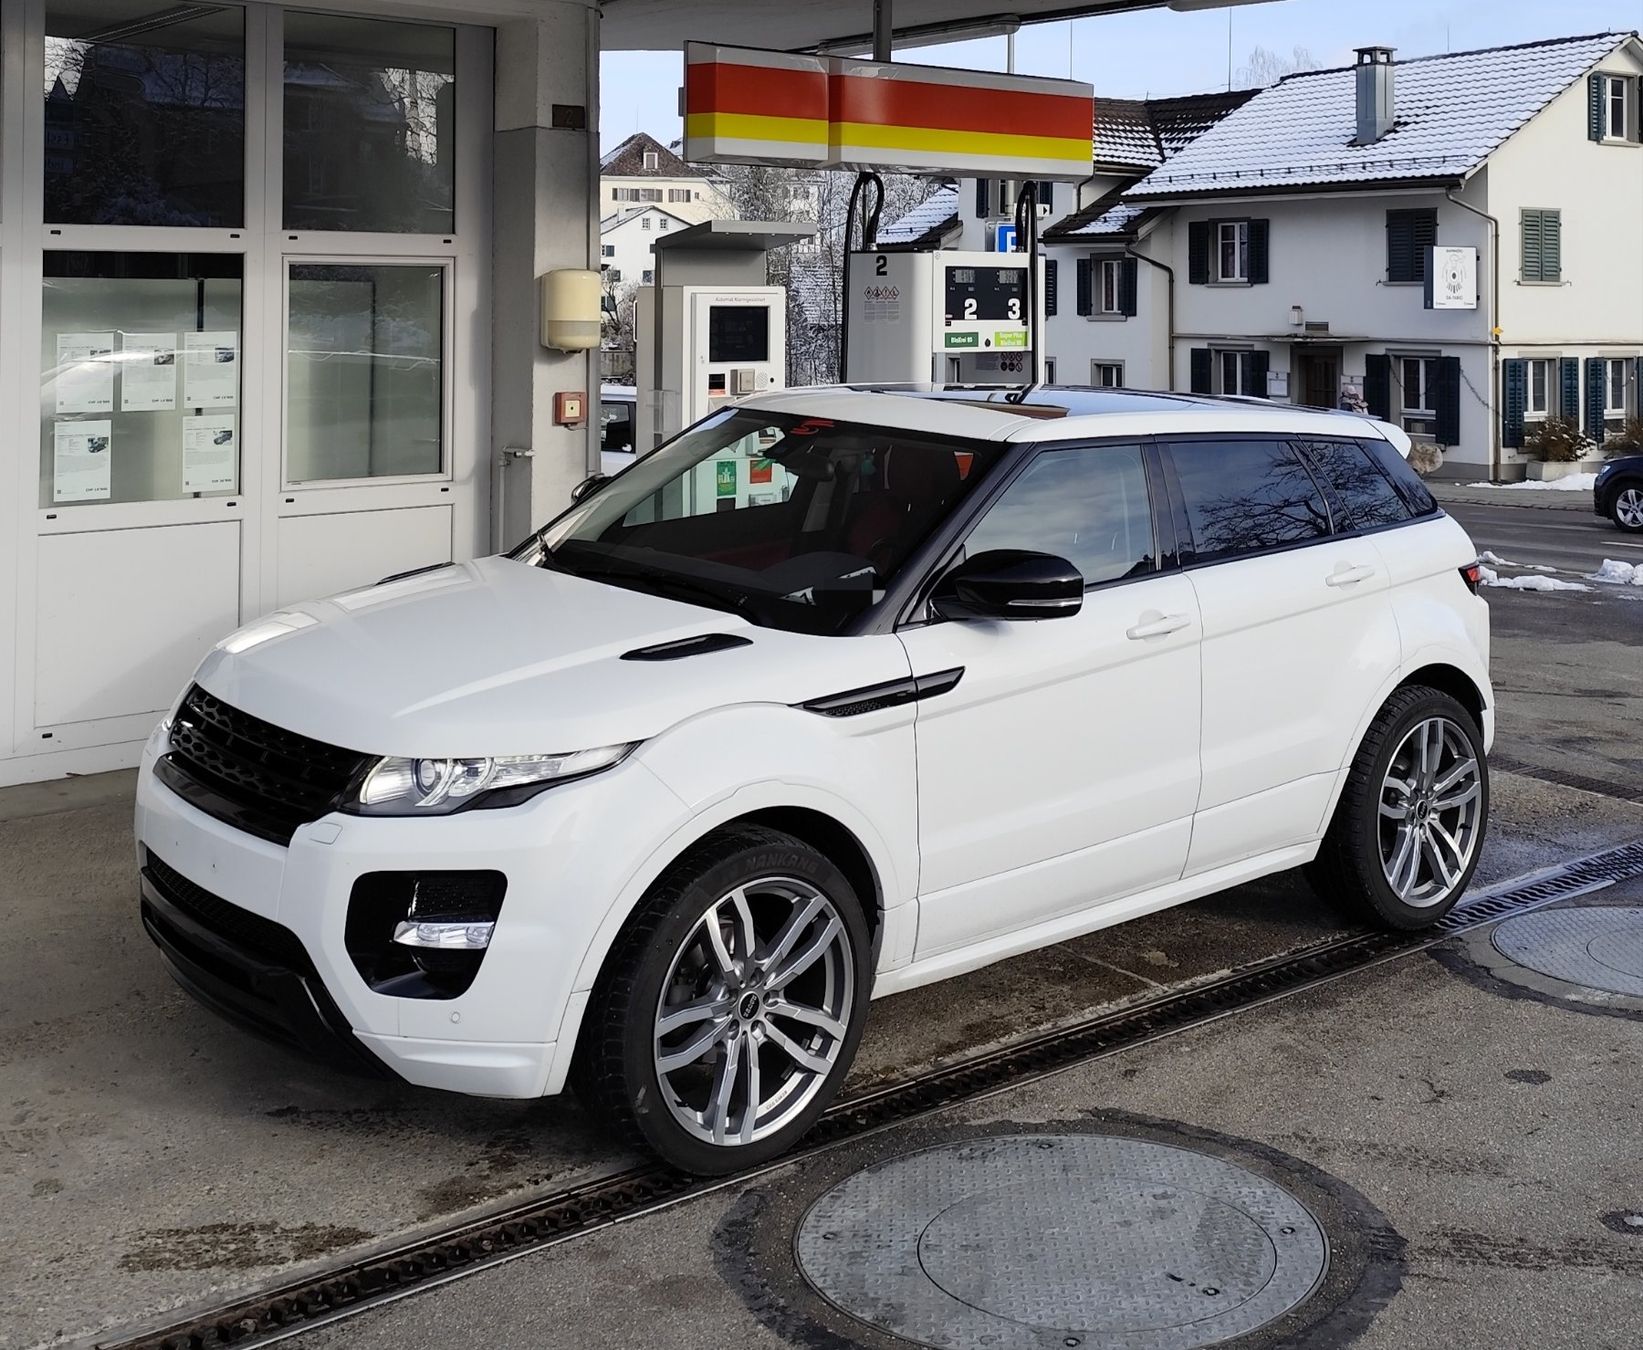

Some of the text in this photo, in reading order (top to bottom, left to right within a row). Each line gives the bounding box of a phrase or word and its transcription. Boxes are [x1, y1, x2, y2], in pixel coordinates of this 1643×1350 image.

[876, 255, 888, 277] 2
[964, 298, 978, 320] 2
[1007, 298, 1021, 320] 3
[744, 852, 819, 875] NANKANG
